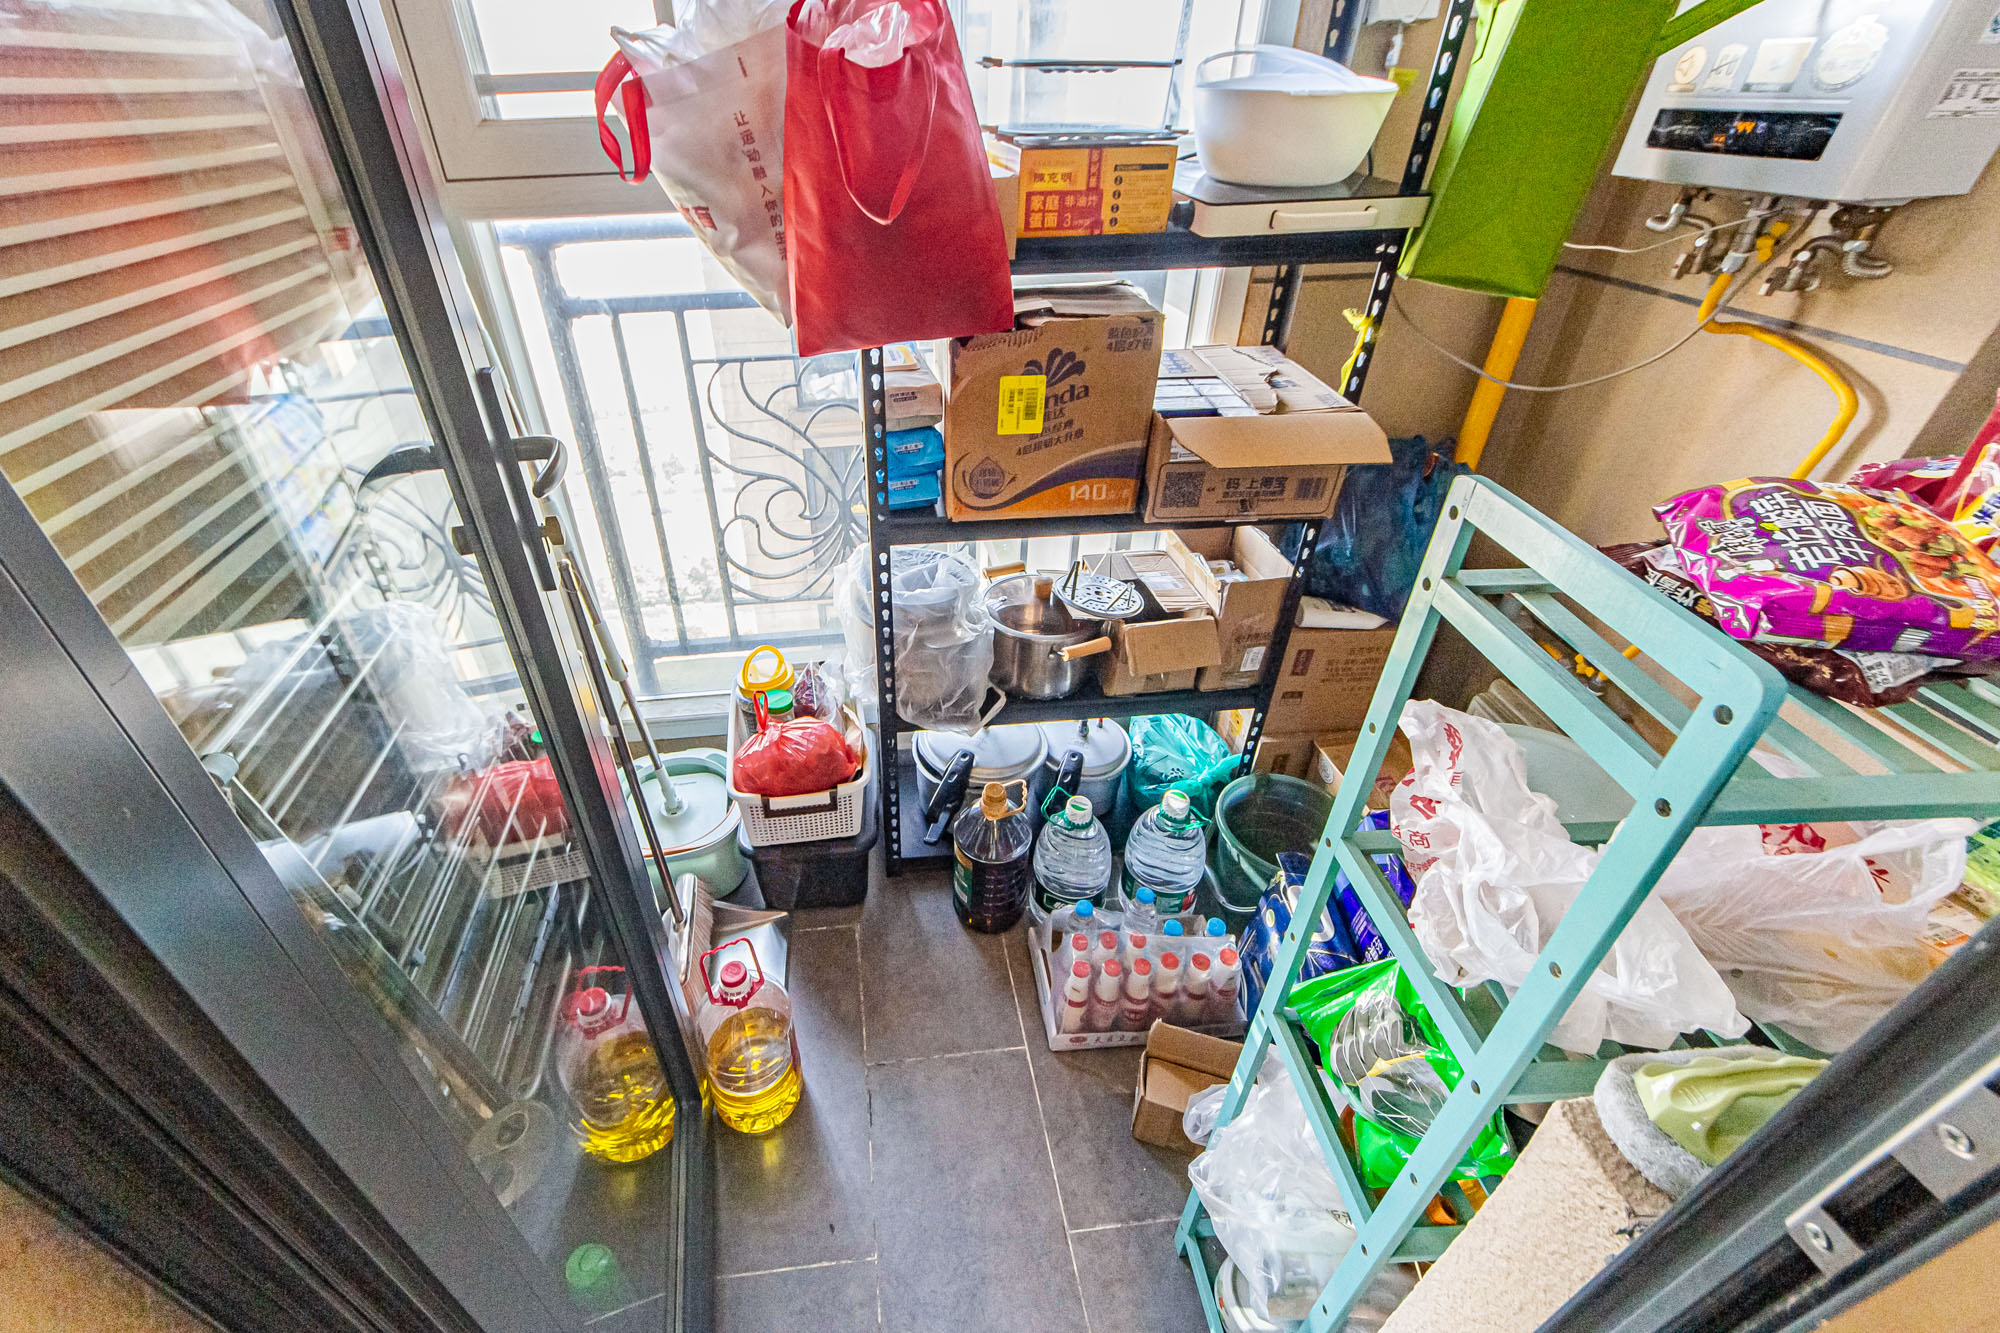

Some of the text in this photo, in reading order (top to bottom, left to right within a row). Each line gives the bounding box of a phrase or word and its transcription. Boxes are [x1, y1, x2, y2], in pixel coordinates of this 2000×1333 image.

[1044, 383, 1089, 410] nda
[1799, 499, 1875, 563] 牛肉面
